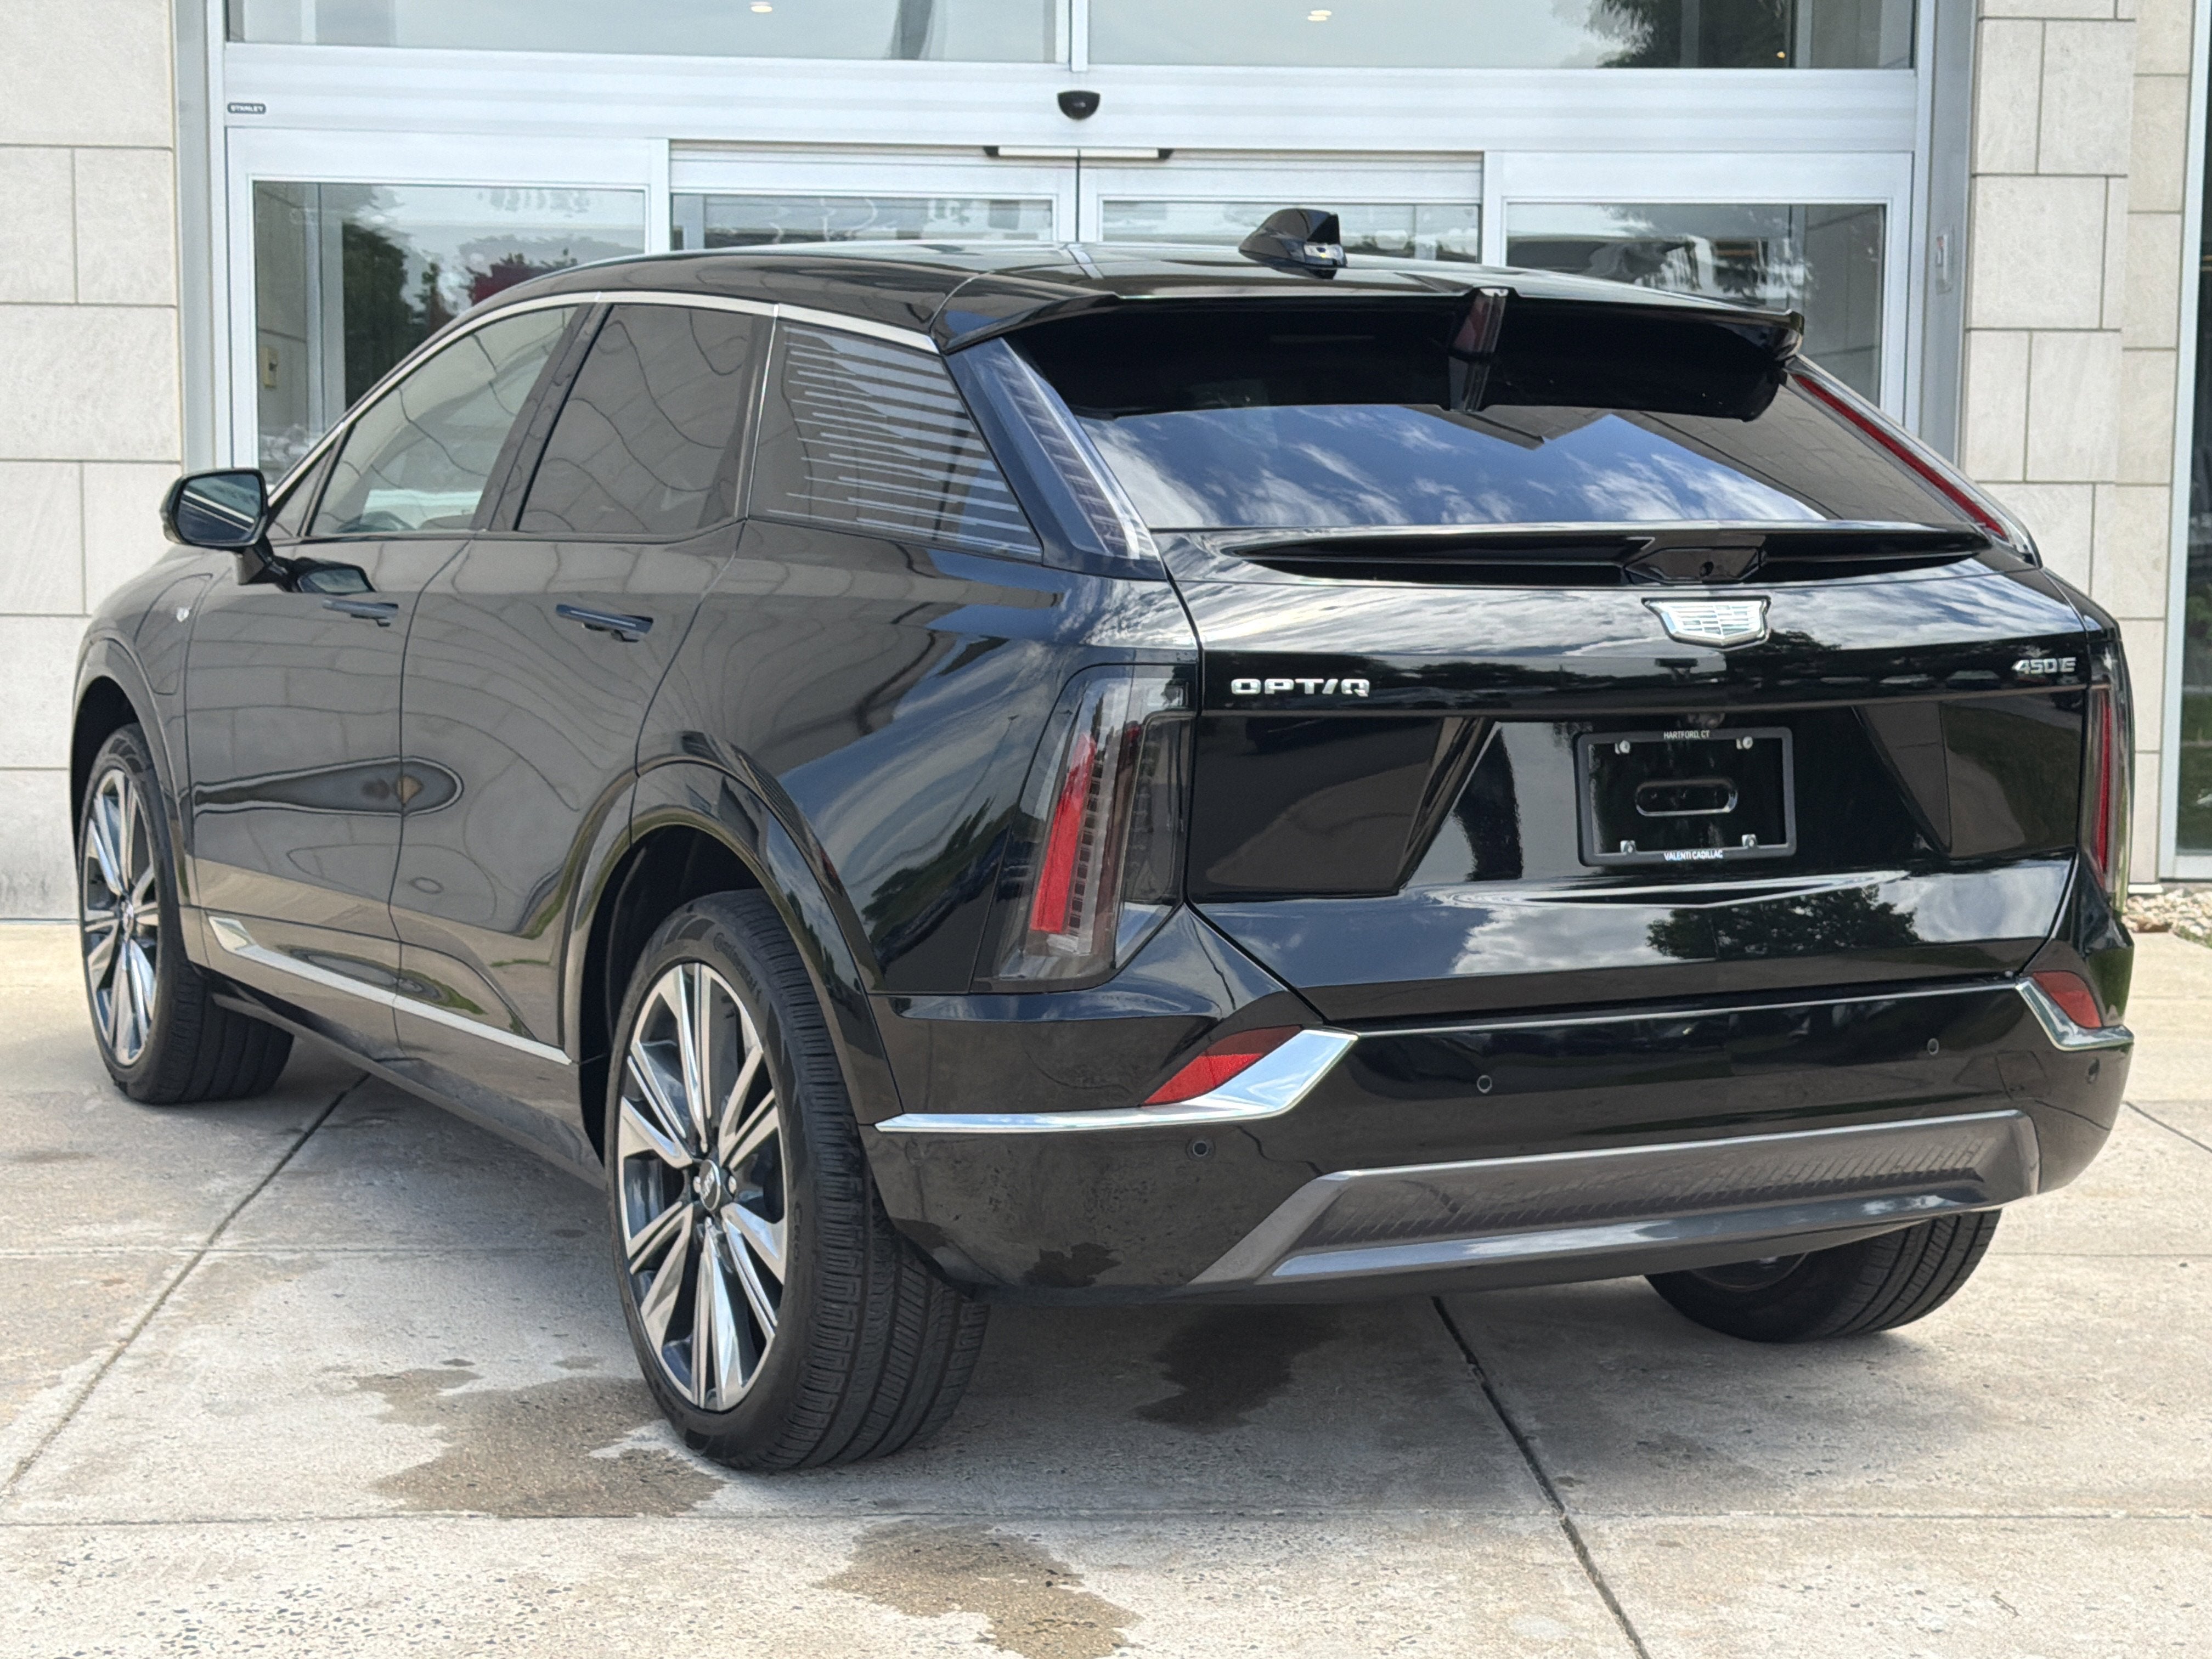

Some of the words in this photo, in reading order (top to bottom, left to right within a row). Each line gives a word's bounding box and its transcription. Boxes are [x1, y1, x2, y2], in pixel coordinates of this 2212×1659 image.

[1701, 730, 1710, 738] CT
[1663, 851, 1691, 861] VALENTI
[1692, 849, 1723, 860] CADILLAC
